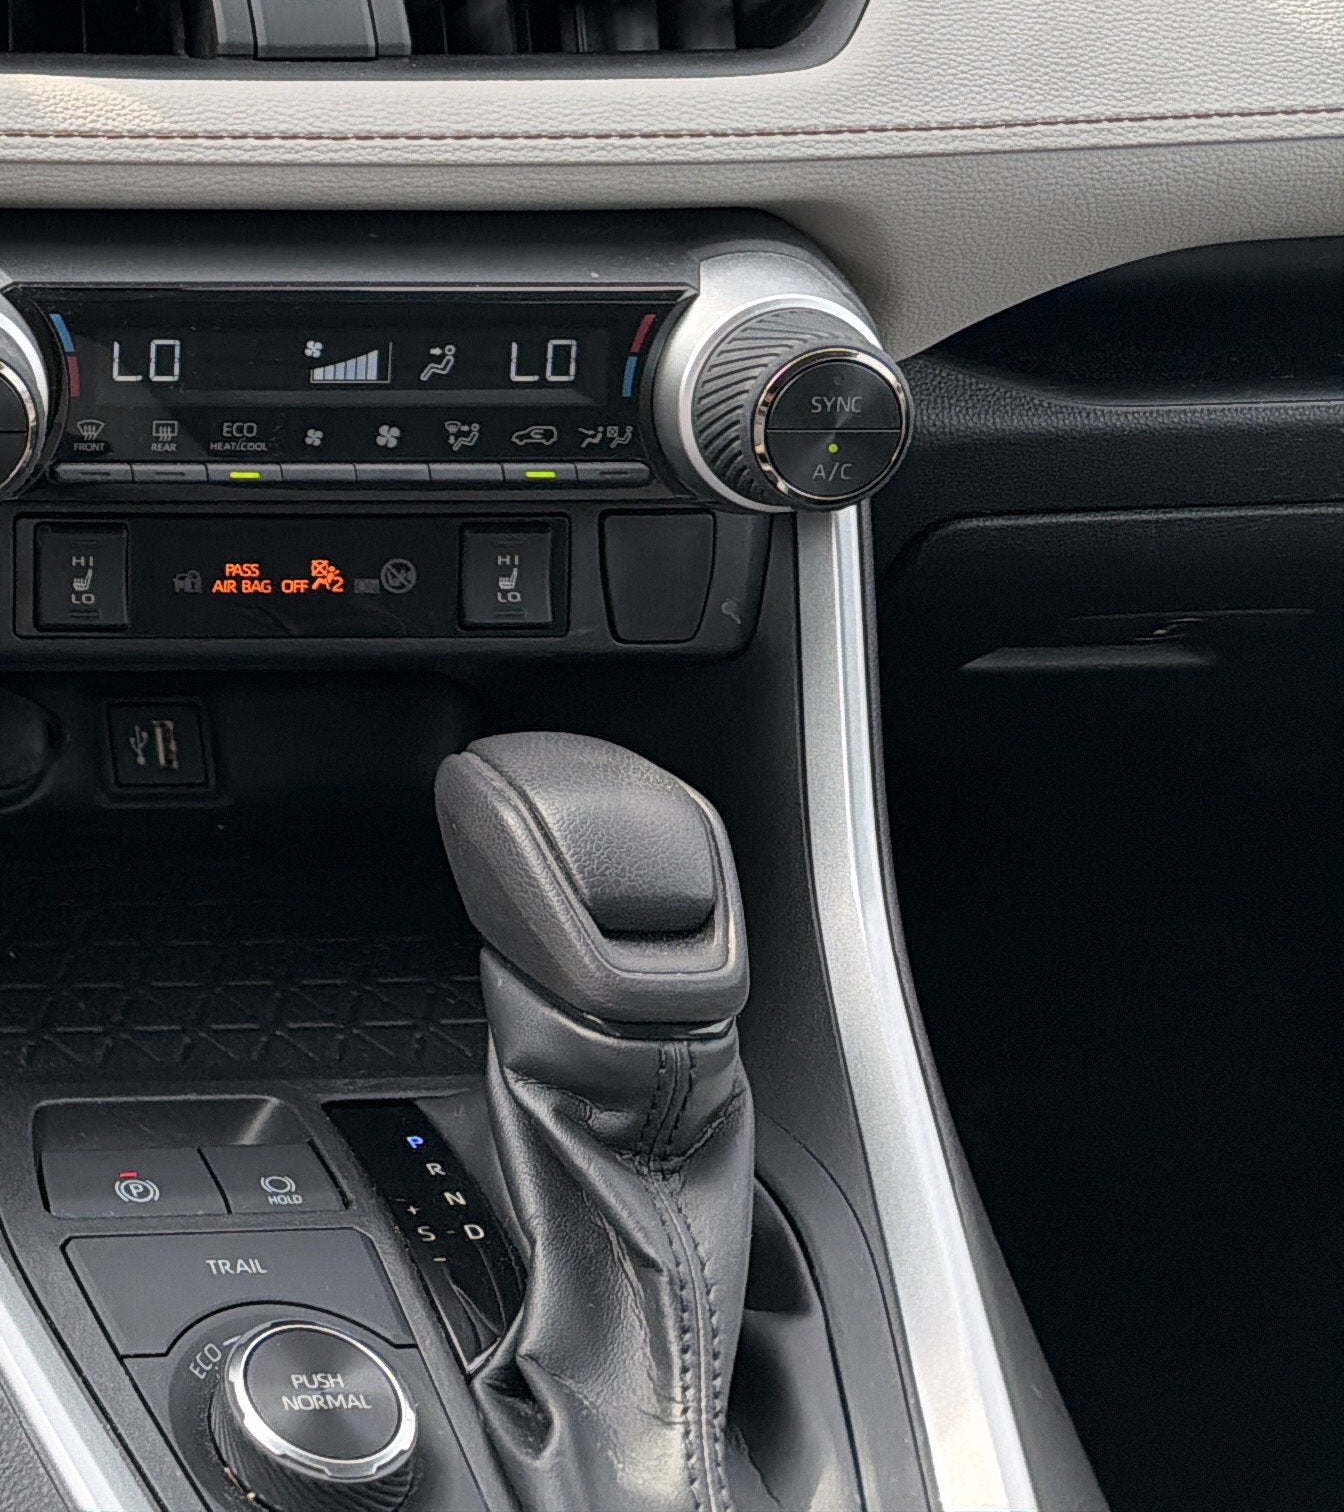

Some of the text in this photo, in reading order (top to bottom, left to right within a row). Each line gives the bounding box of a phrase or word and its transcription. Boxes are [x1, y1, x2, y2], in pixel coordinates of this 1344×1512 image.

[112, 338, 181, 382] LO
[509, 338, 577, 382] LO
[810, 395, 863, 415] SYNC
[223, 422, 257, 437] ECO
[73, 442, 105, 452] FRONT
[150, 442, 177, 452] REAR
[812, 462, 854, 482] A/C
[72, 556, 95, 568] HI
[497, 554, 520, 567] HI
[225, 563, 260, 578] PASS
[212, 578, 237, 593] AIR
[241, 578, 273, 594] BAG
[281, 578, 310, 593] OFF
[71, 593, 95, 605] LO
[496, 591, 522, 604] LO
[406, 1135, 425, 1150] P
[425, 1162, 446, 1176] R
[267, 1194, 303, 1206] HOLD
[443, 1191, 466, 1206] N
[417, 1226, 436, 1242] S
[464, 1224, 485, 1240] D
[205, 1258, 268, 1276] TRAIL
[189, 1342, 223, 1380] ECO
[291, 1373, 345, 1390] PUSH
[281, 1394, 373, 1411] NORMAL
